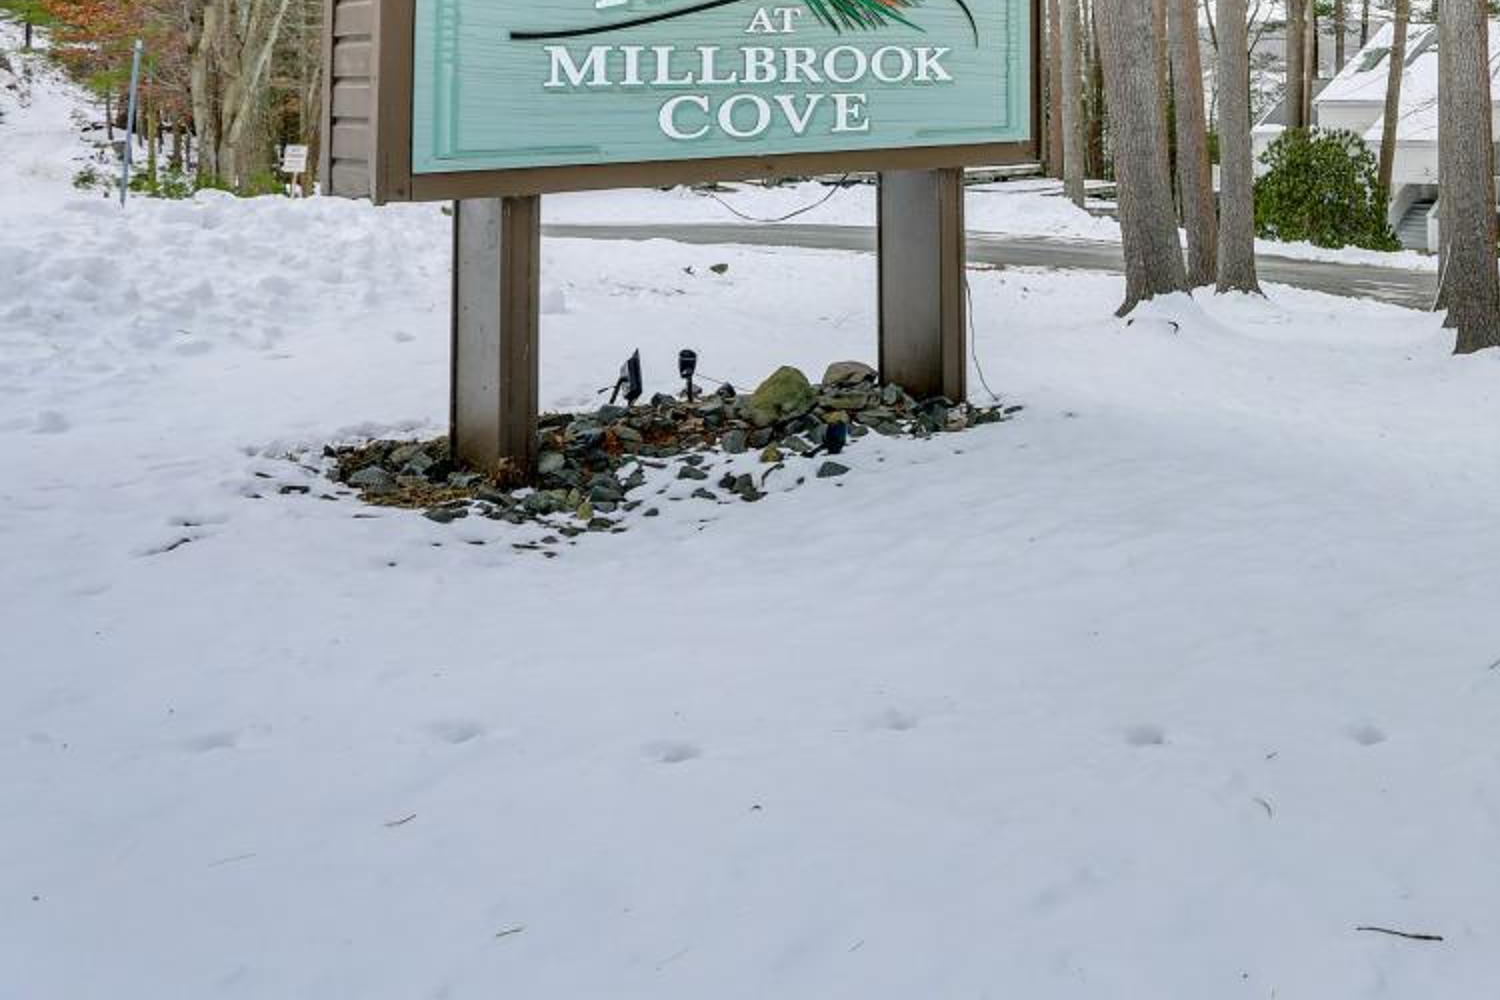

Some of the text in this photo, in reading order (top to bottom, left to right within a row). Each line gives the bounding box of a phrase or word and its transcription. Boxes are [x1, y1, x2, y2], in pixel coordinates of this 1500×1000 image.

[746, 7, 801, 33] AT
[543, 45, 953, 88] MILLBROOK
[658, 92, 870, 140] COVE
